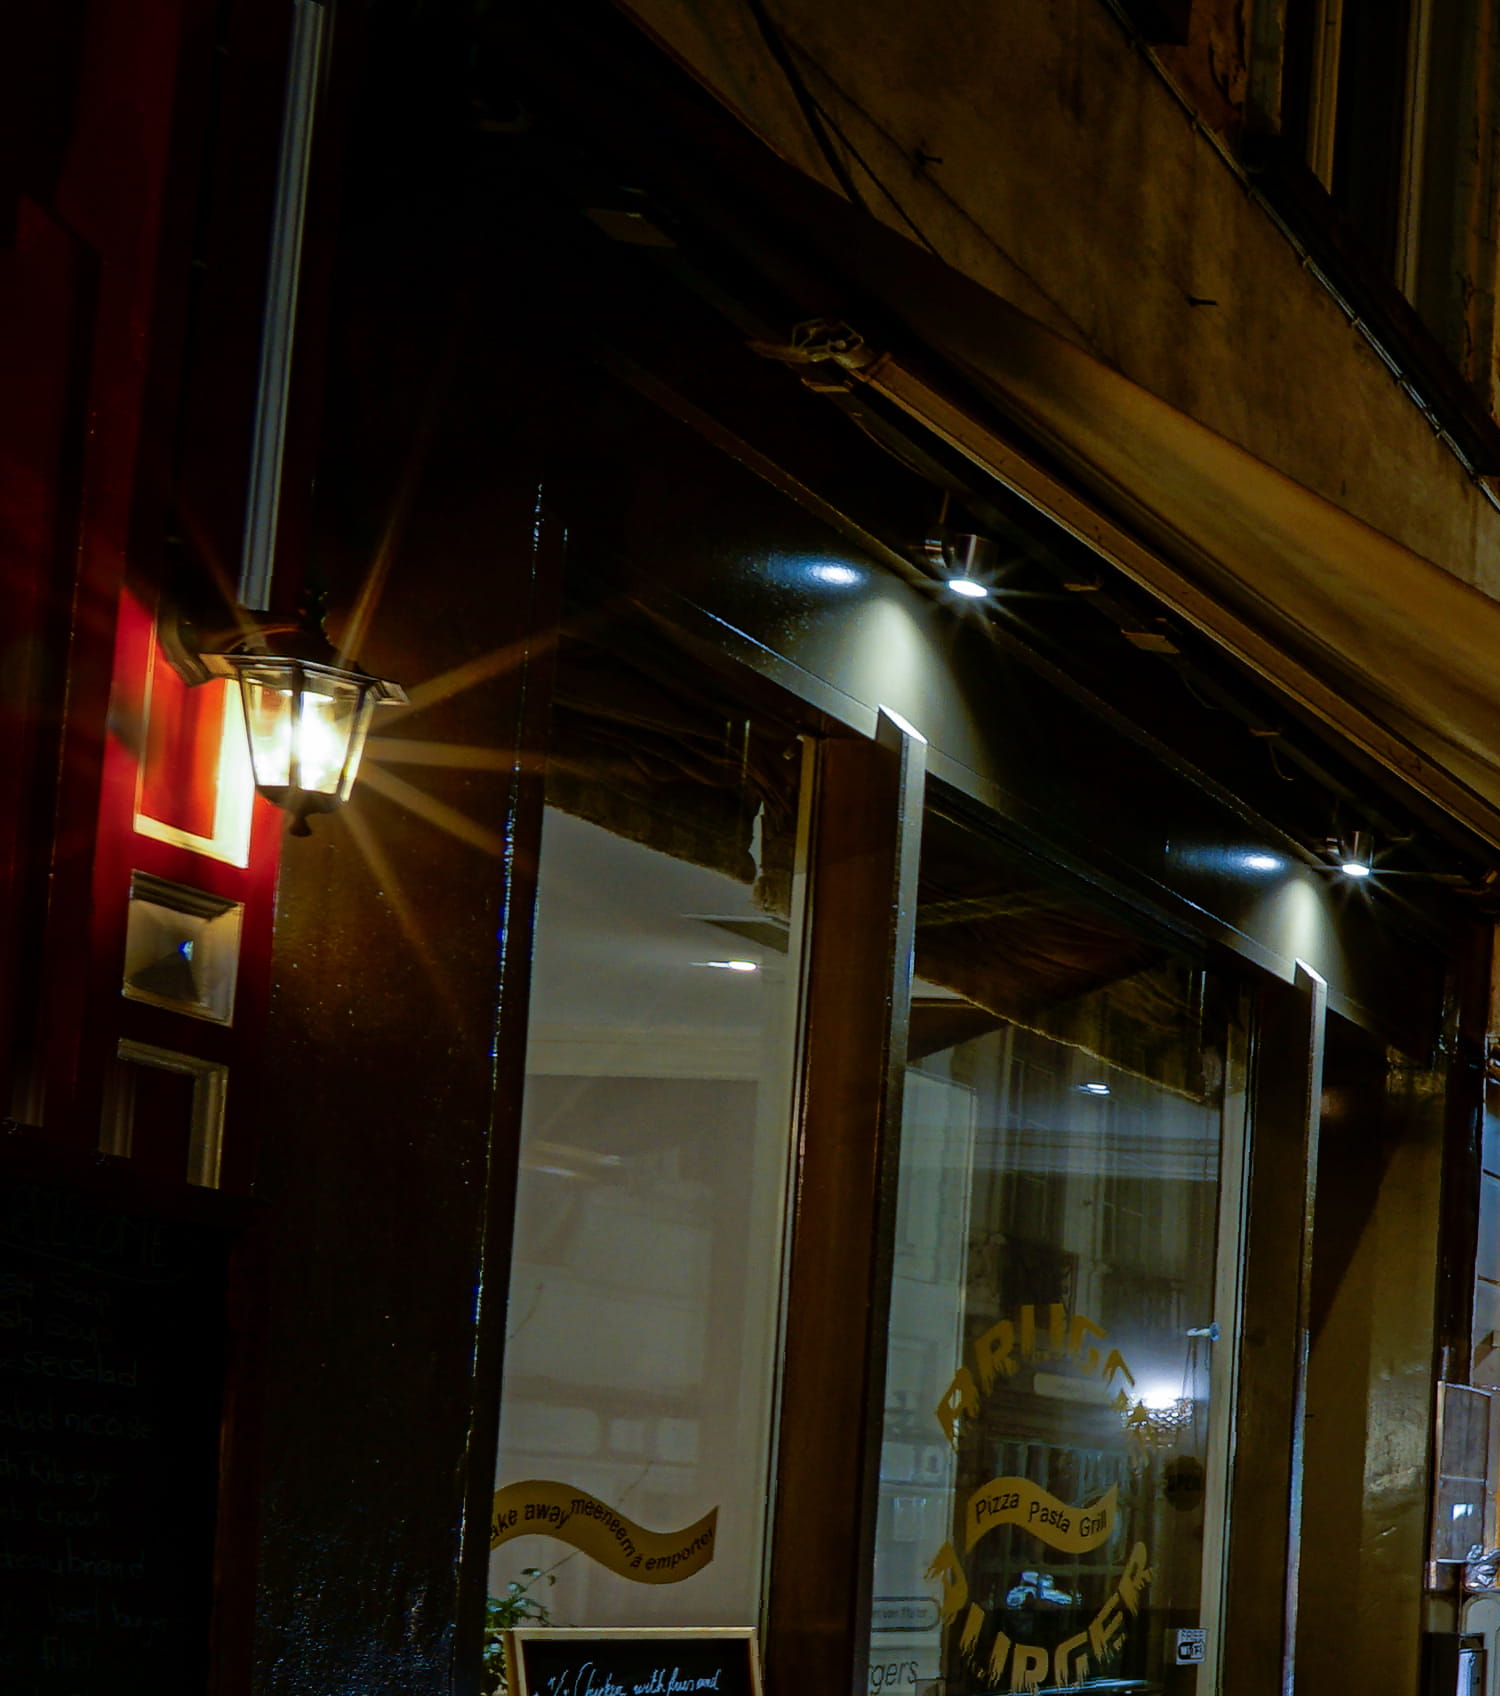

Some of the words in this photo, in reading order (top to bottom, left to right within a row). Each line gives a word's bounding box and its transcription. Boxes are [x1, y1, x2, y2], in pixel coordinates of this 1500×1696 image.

[489, 1509, 518, 1540] ake
[524, 1503, 570, 1529] away
[569, 1499, 636, 1557] meeneem
[975, 1492, 1021, 1524] Pizza
[1028, 1501, 1070, 1533] Pasta
[1079, 1509, 1108, 1537] Grill
[632, 1668, 666, 1696] with
[870, 1660, 919, 1696] gers
